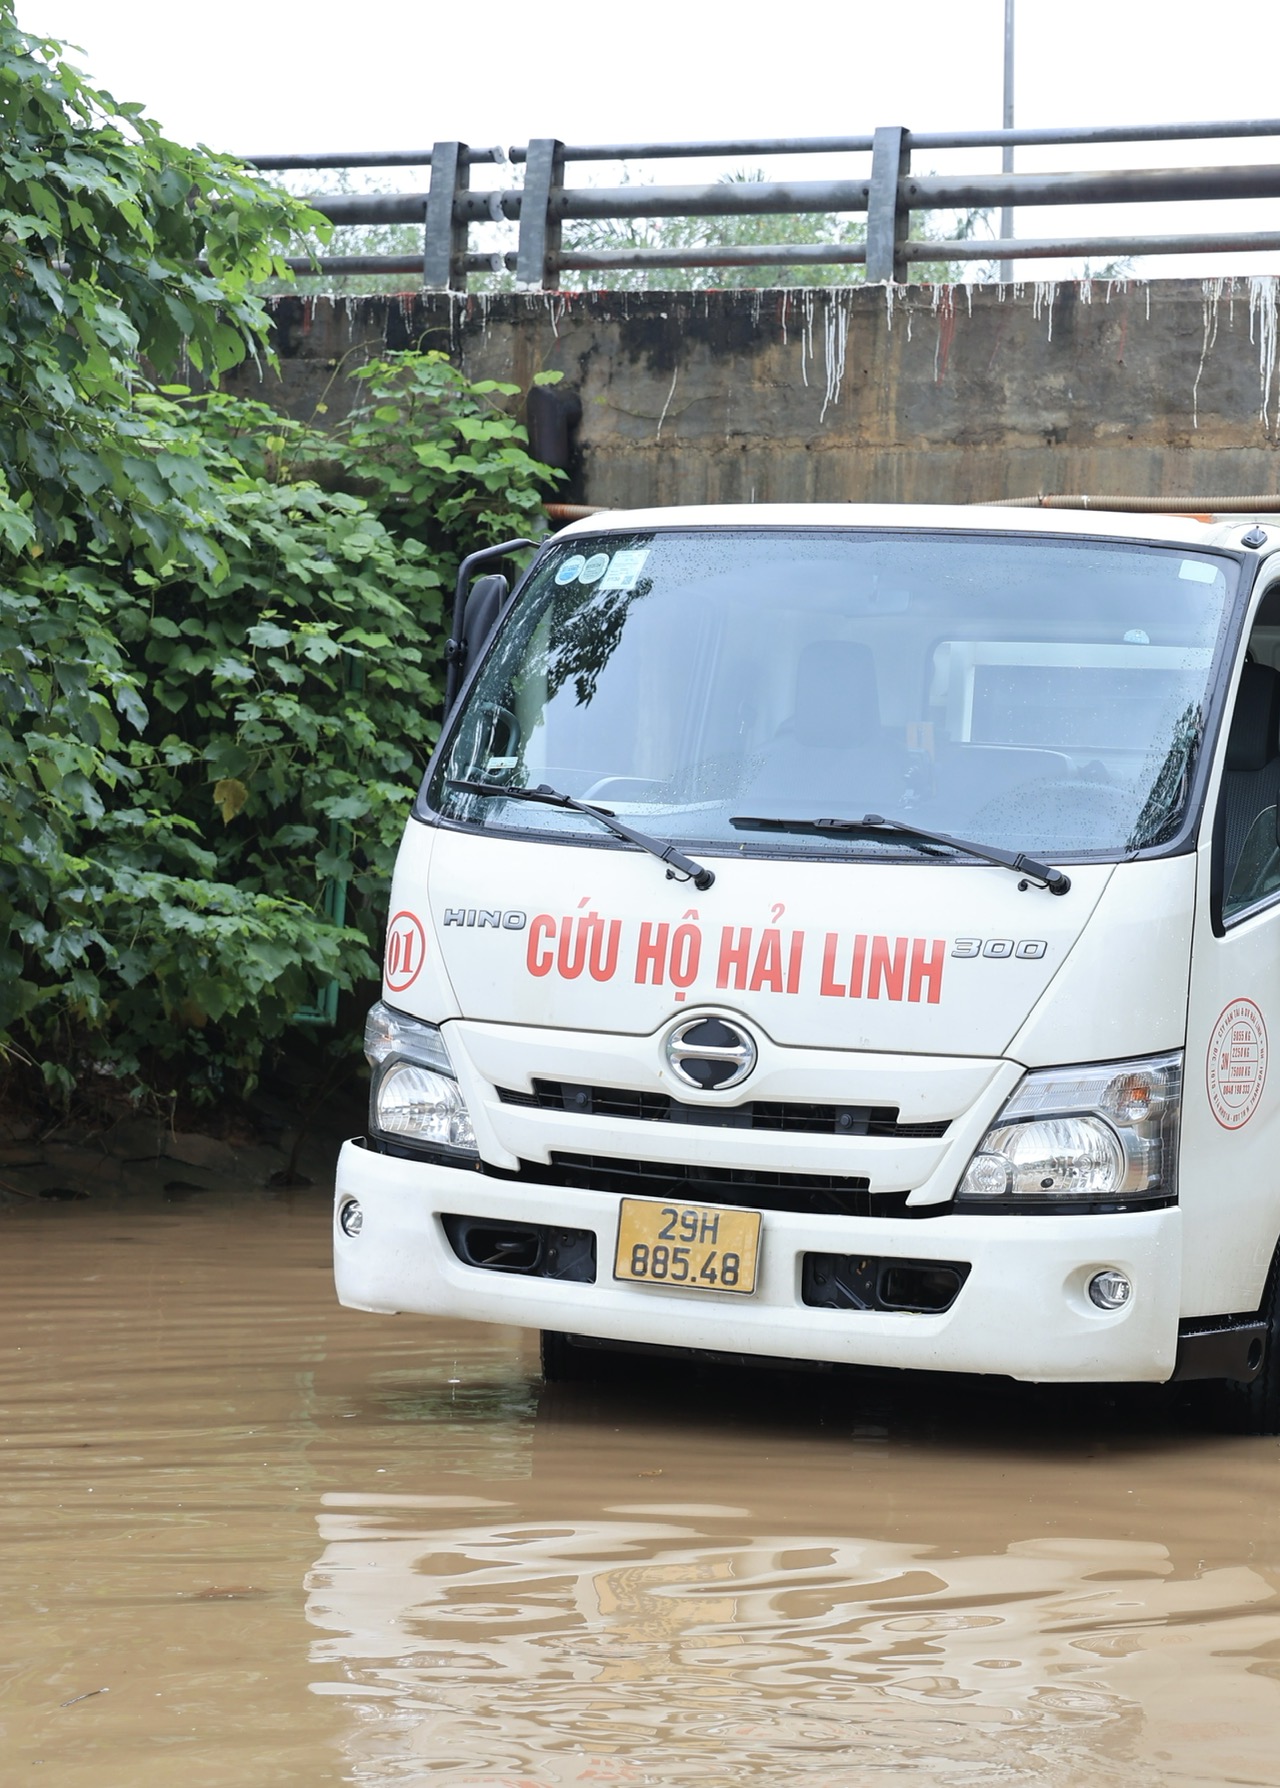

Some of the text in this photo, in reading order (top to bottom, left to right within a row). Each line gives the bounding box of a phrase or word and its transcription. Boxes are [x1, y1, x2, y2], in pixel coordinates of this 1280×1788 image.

[443, 908, 527, 930] HINO
[388, 929, 414, 976] 01
[526, 896, 946, 1005] CỨU HỘ HẢI LINH
[950, 937, 1048, 959] 300
[658, 1208, 720, 1244] 29H
[630, 1243, 740, 1286] 885.48
